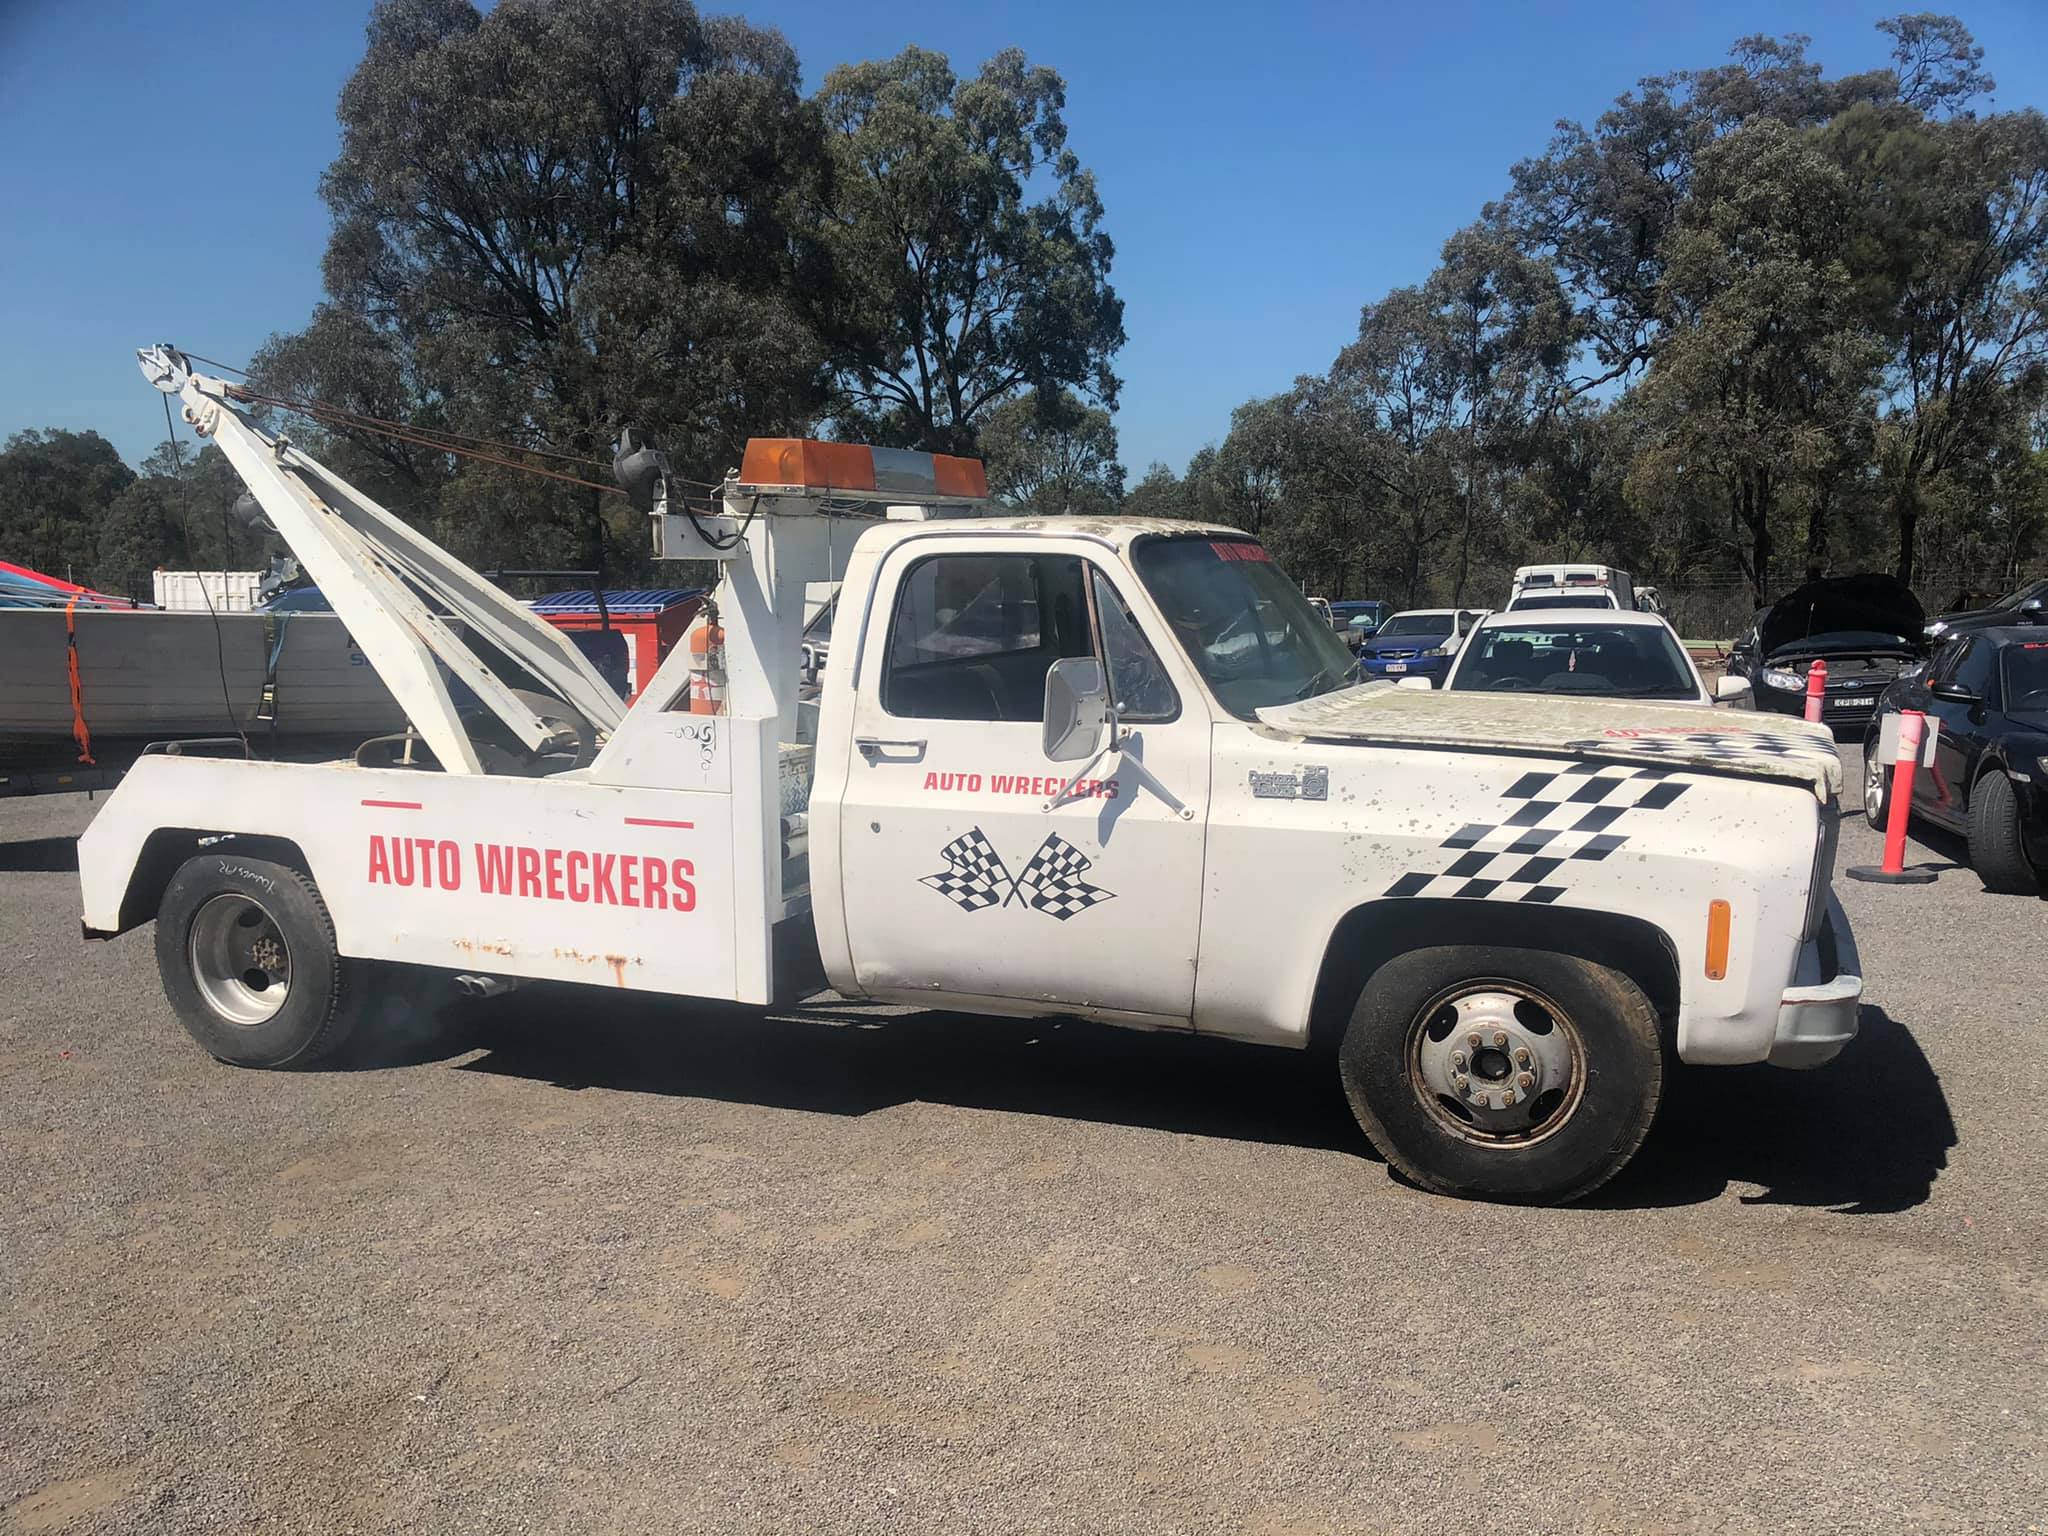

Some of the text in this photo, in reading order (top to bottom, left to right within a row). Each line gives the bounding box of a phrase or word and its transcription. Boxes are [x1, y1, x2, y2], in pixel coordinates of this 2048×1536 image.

[924, 772, 982, 792] AUTO
[368, 834, 696, 912] AUTO WRECKERS
